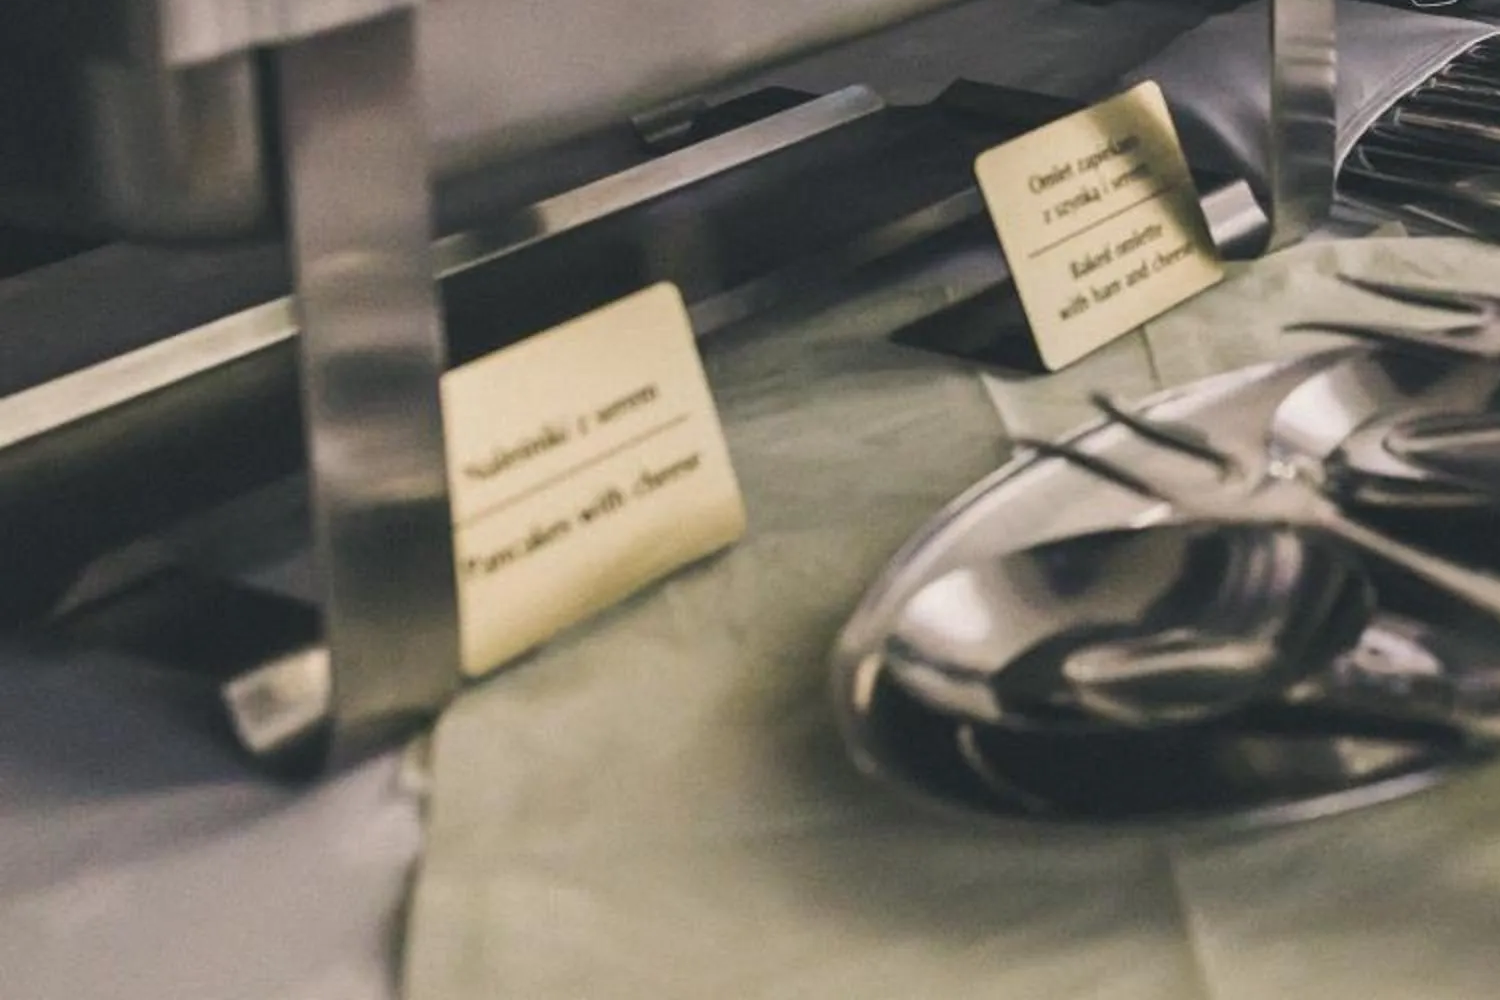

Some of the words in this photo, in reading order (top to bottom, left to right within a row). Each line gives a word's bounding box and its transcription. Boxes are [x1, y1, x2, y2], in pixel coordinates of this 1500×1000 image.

[1070, 244, 1113, 279] Baked
[1060, 292, 1090, 321] with
[1092, 278, 1121, 302] ham
[1126, 260, 1149, 287] and
